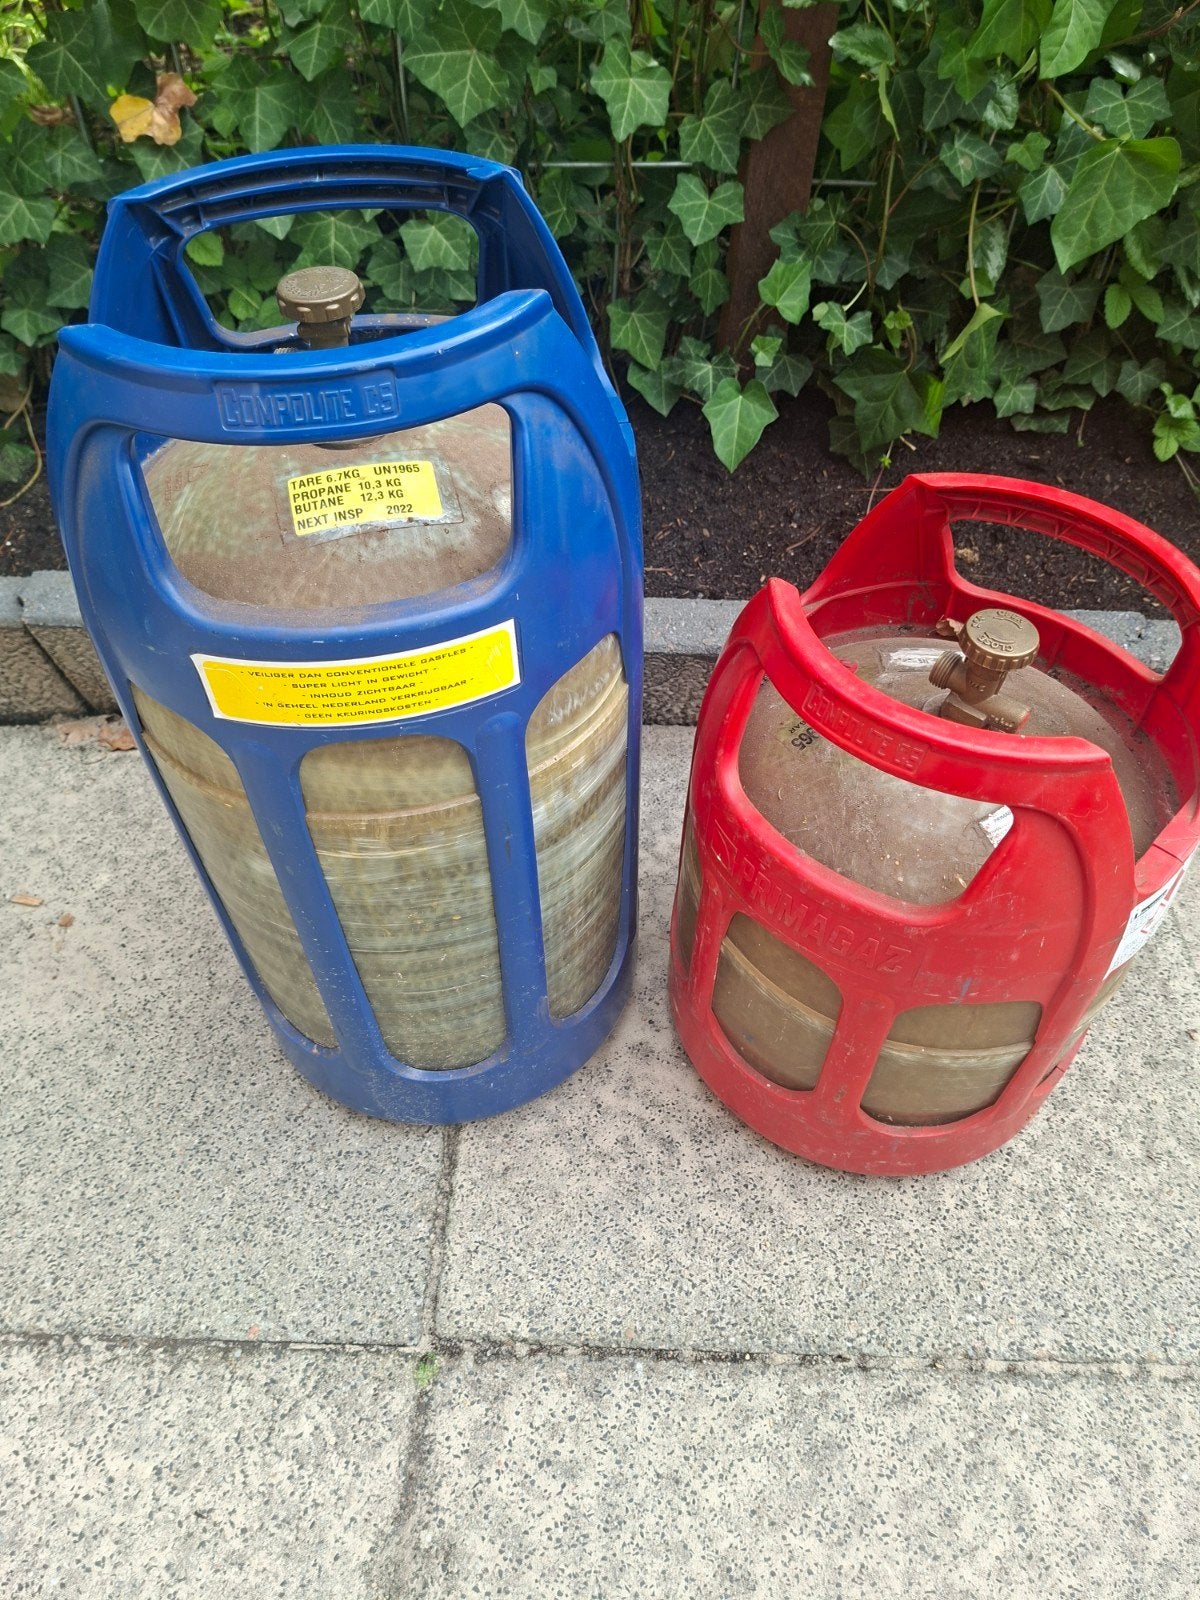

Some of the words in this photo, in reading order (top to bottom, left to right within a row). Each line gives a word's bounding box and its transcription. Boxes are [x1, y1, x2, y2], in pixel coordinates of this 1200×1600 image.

[222, 388, 357, 427] COMPOLITE
[290, 475, 323, 491] TARE
[326, 468, 361, 484] 6.7KG
[373, 463, 421, 477] UN1965
[292, 482, 352, 504] PROPANE
[386, 477, 402, 488] KG
[294, 496, 345, 515] BUTANE
[360, 491, 385, 503] 12,3
[388, 489, 404, 499] KG
[297, 513, 329, 531] NEXT
[334, 507, 364, 522] INSP
[387, 503, 414, 515] 2022
[977, 634, 1014, 653] CLOSE
[247, 670, 295, 679] VEILIGER
[326, 660, 417, 678] CONVENTIONELE
[420, 648, 467, 665] GASFLES
[310, 691, 352, 699] INHOUD
[357, 682, 416, 696] ZICHTBAAR
[332, 680, 362, 688] LICHT
[382, 668, 430, 683] GEWICHT
[322, 697, 387, 708] NEDERLAND
[390, 679, 468, 702] VERKRIJGBAAR
[336, 699, 432, 718] KEURINGSKOSTEN
[807, 685, 895, 757] COMPOLITE
[738, 856, 912, 974] PRIMAGAZ
